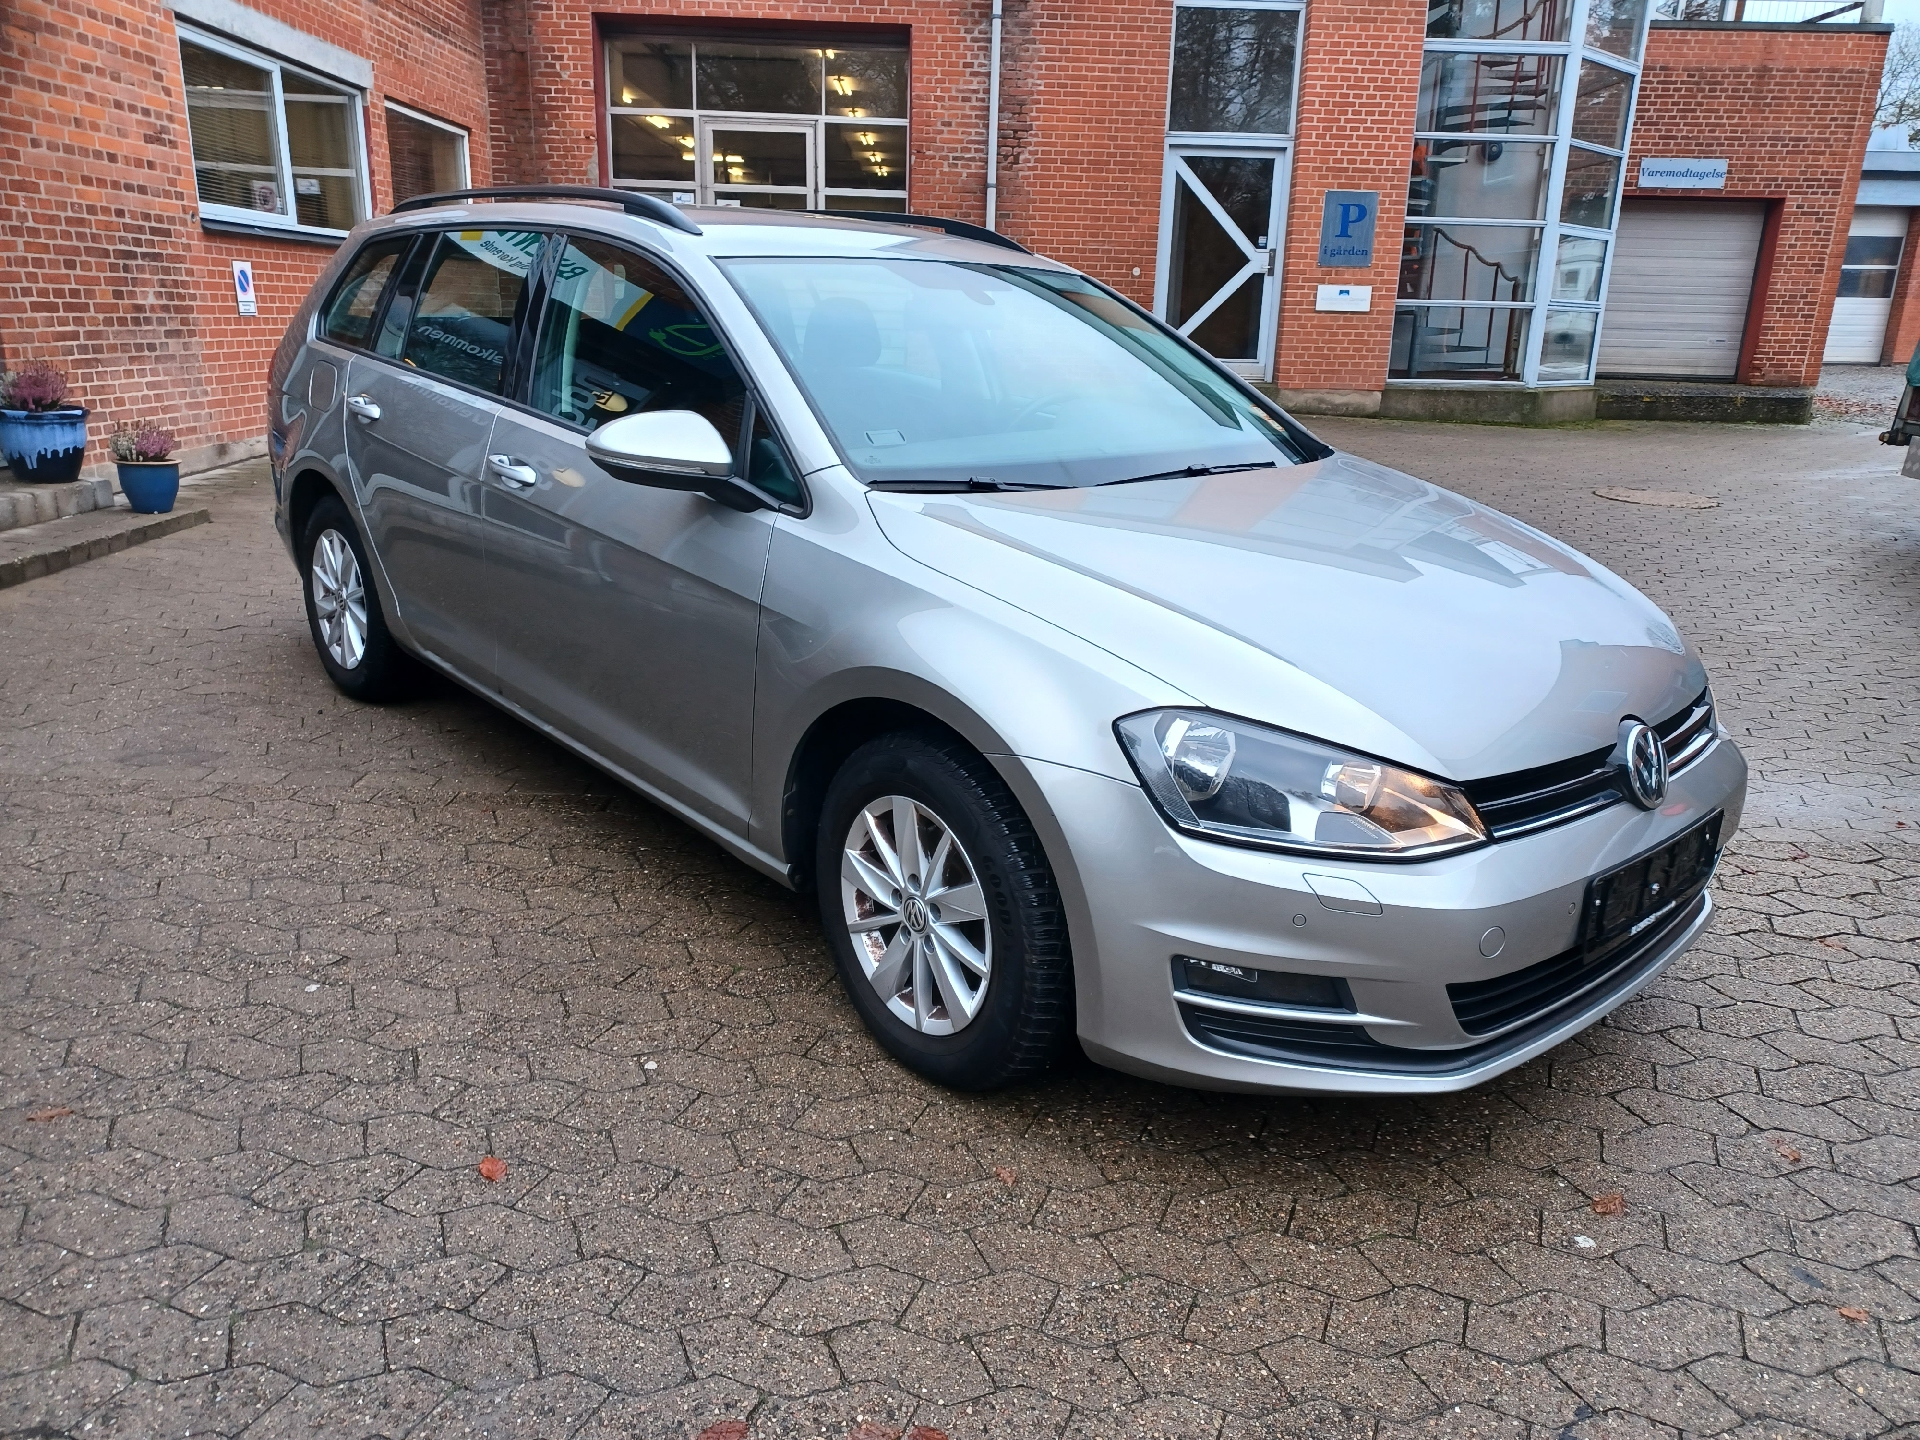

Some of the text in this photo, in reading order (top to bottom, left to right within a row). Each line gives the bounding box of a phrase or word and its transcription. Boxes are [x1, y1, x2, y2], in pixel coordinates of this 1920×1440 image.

[1641, 167, 1727, 181] Varemodtagelse
[1334, 203, 1368, 239] P
[1323, 245, 1369, 258] i gården
